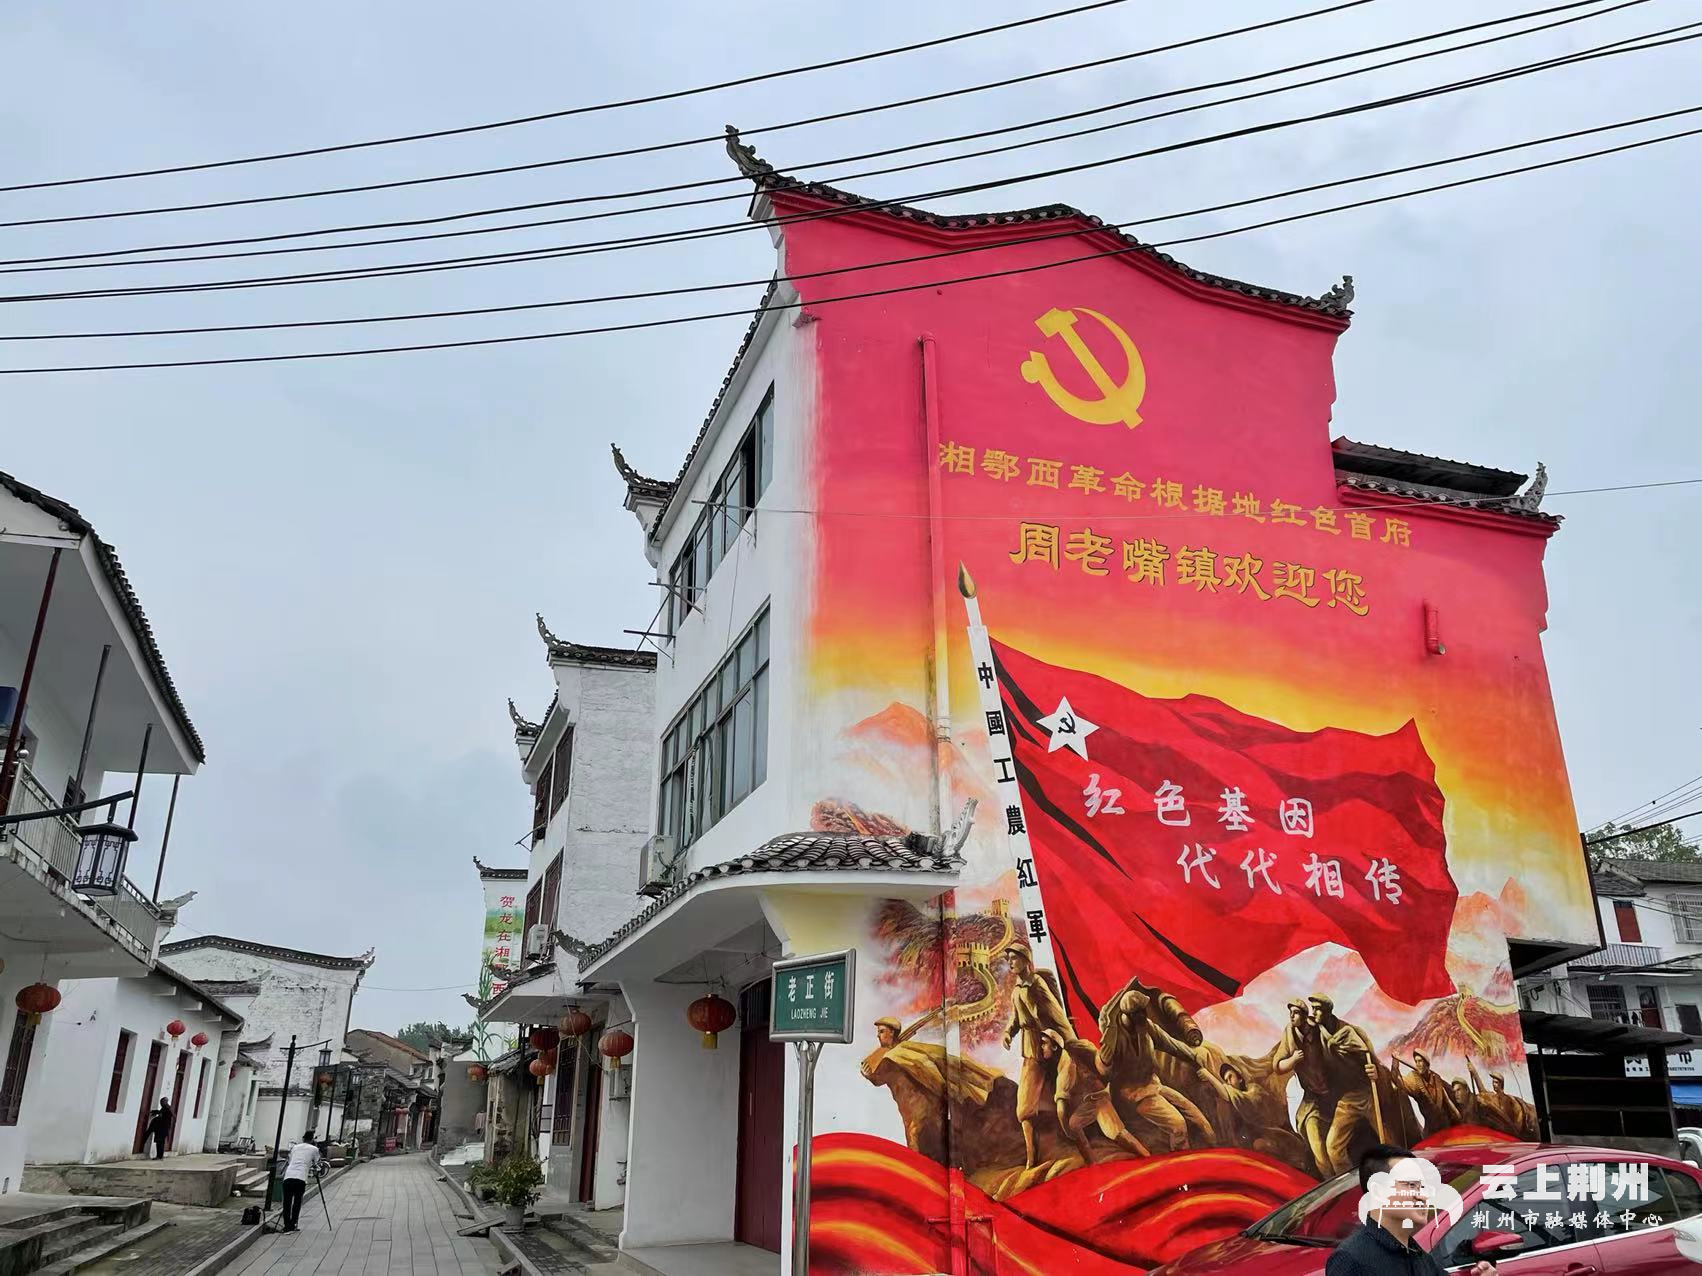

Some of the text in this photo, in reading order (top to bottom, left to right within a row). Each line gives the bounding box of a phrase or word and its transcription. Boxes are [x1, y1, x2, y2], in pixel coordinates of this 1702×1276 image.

[938, 441, 1412, 547] 湘鄂西革命根据地红色首府
[1009, 522, 1369, 616] 周老嘴镇欢迎您
[978, 662, 1047, 943] 中國工農紅軍
[1083, 773, 1315, 838] 红色基因
[1177, 844, 1403, 904] 代代相传
[788, 971, 834, 1002] 老正街
[790, 1007, 829, 1020] LAOZHENG JIE
